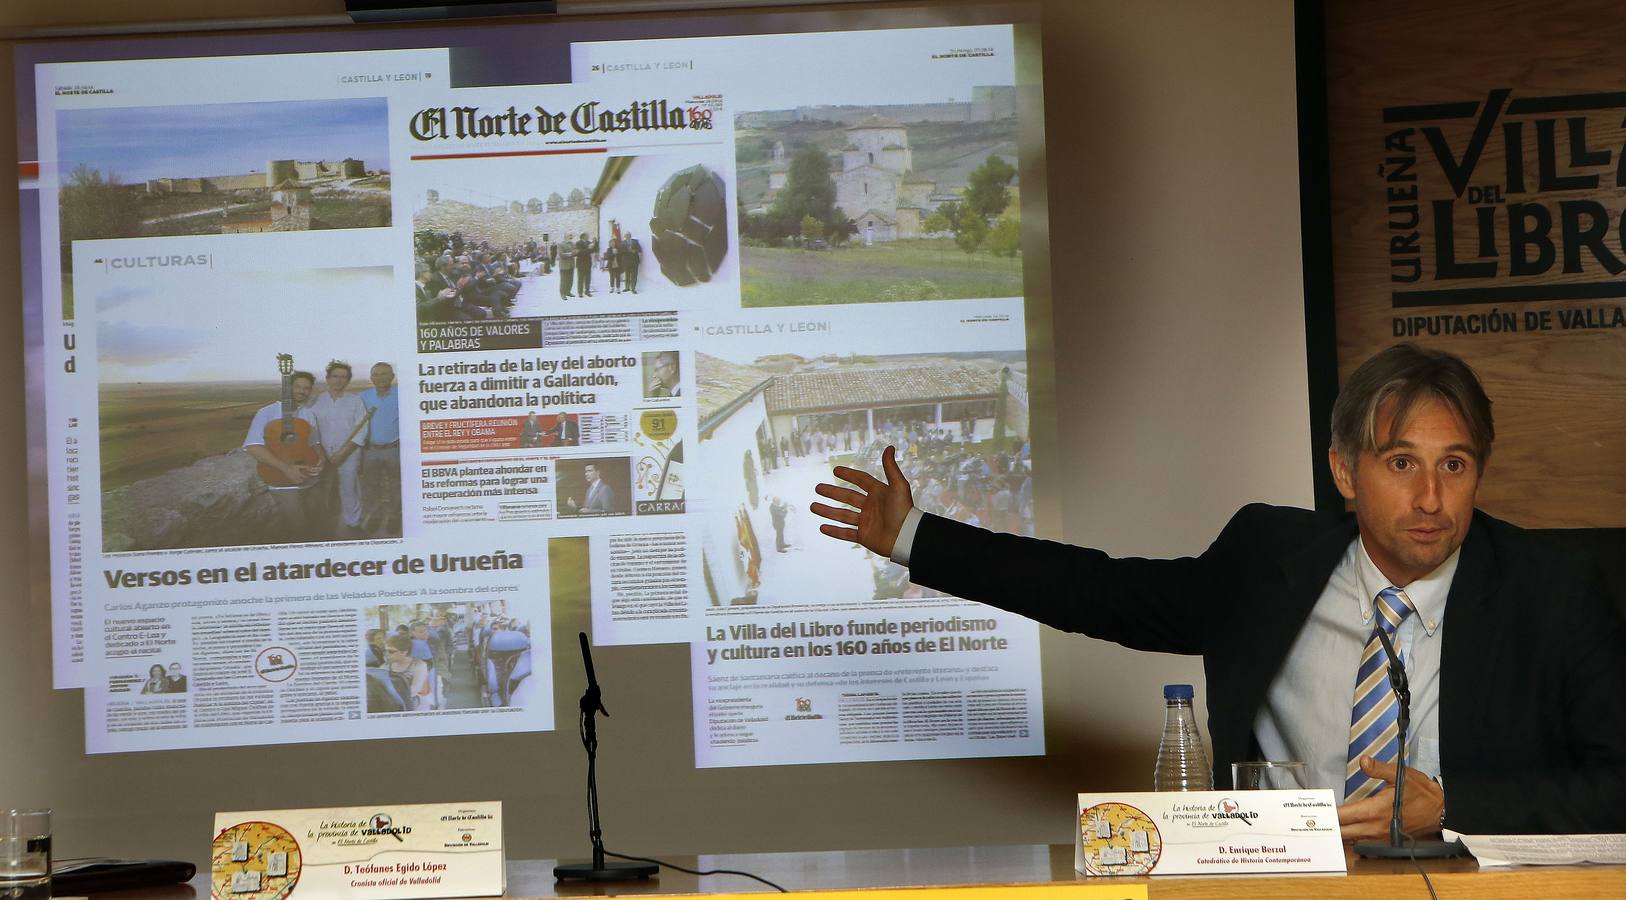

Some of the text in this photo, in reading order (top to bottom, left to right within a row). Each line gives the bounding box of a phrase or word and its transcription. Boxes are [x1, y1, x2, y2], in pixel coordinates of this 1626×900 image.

[409, 106, 449, 141] El
[450, 105, 532, 139] Norte
[534, 105, 567, 135] de
[570, 99, 689, 135] Castilla
[1420, 88, 1626, 199] VILL
[1468, 184, 1506, 204] DEL
[1377, 127, 1423, 283] URUEÑA
[1432, 199, 1626, 281] LIBR
[111, 254, 208, 269] CULTURAS
[706, 324, 773, 336] CASTILLA
[777, 323, 784, 333] Y
[1392, 308, 1517, 337] DIPUTACIÓN
[1525, 310, 1552, 331] DE
[420, 327, 438, 340] 160
[440, 325, 468, 339] AÑOS
[470, 326, 482, 337] DE
[484, 324, 530, 337] VALORES
[420, 338, 481, 351] Y PALABRAS
[419, 355, 636, 377] La retirada de la ley del aborto
[419, 372, 618, 394] fuerza a dimitir a Gallardón,
[419, 391, 596, 414] que abandona la política
[423, 430, 444, 438] ENTRE
[452, 429, 465, 437] REY
[421, 464, 547, 478] El BBVA plantea ahondar en
[422, 476, 548, 488] las reformas para lograr una
[422, 486, 538, 501] recuperación más intensa
[104, 550, 523, 589] Versos en el atardecer de Urueña
[104, 602, 132, 611] Carlos
[134, 601, 169, 612] Aganzo
[230, 596, 264, 605] anoche
[274, 593, 312, 605] primera
[313, 593, 324, 601] de
[326, 591, 339, 600] las
[340, 589, 377, 599] Veladas
[439, 585, 474, 595] sombra
[475, 584, 489, 593] del
[707, 615, 997, 641] La Villa del Libro funde periodismo
[707, 635, 1007, 664] y cultura en los 160 años de El Norte
[1182, 804, 1206, 812] historia
[1208, 804, 1215, 812] de
[330, 820, 356, 829] historia
[1172, 812, 1200, 823] provincia
[316, 830, 348, 842] provincia
[1219, 845, 1286, 855] D. Enrique Berzal
[344, 861, 447, 874] D. Teófanes Egido López
[1265, 856, 1311, 864] Contemporánea
[351, 876, 441, 888] Cronista oficial de Valladolid
